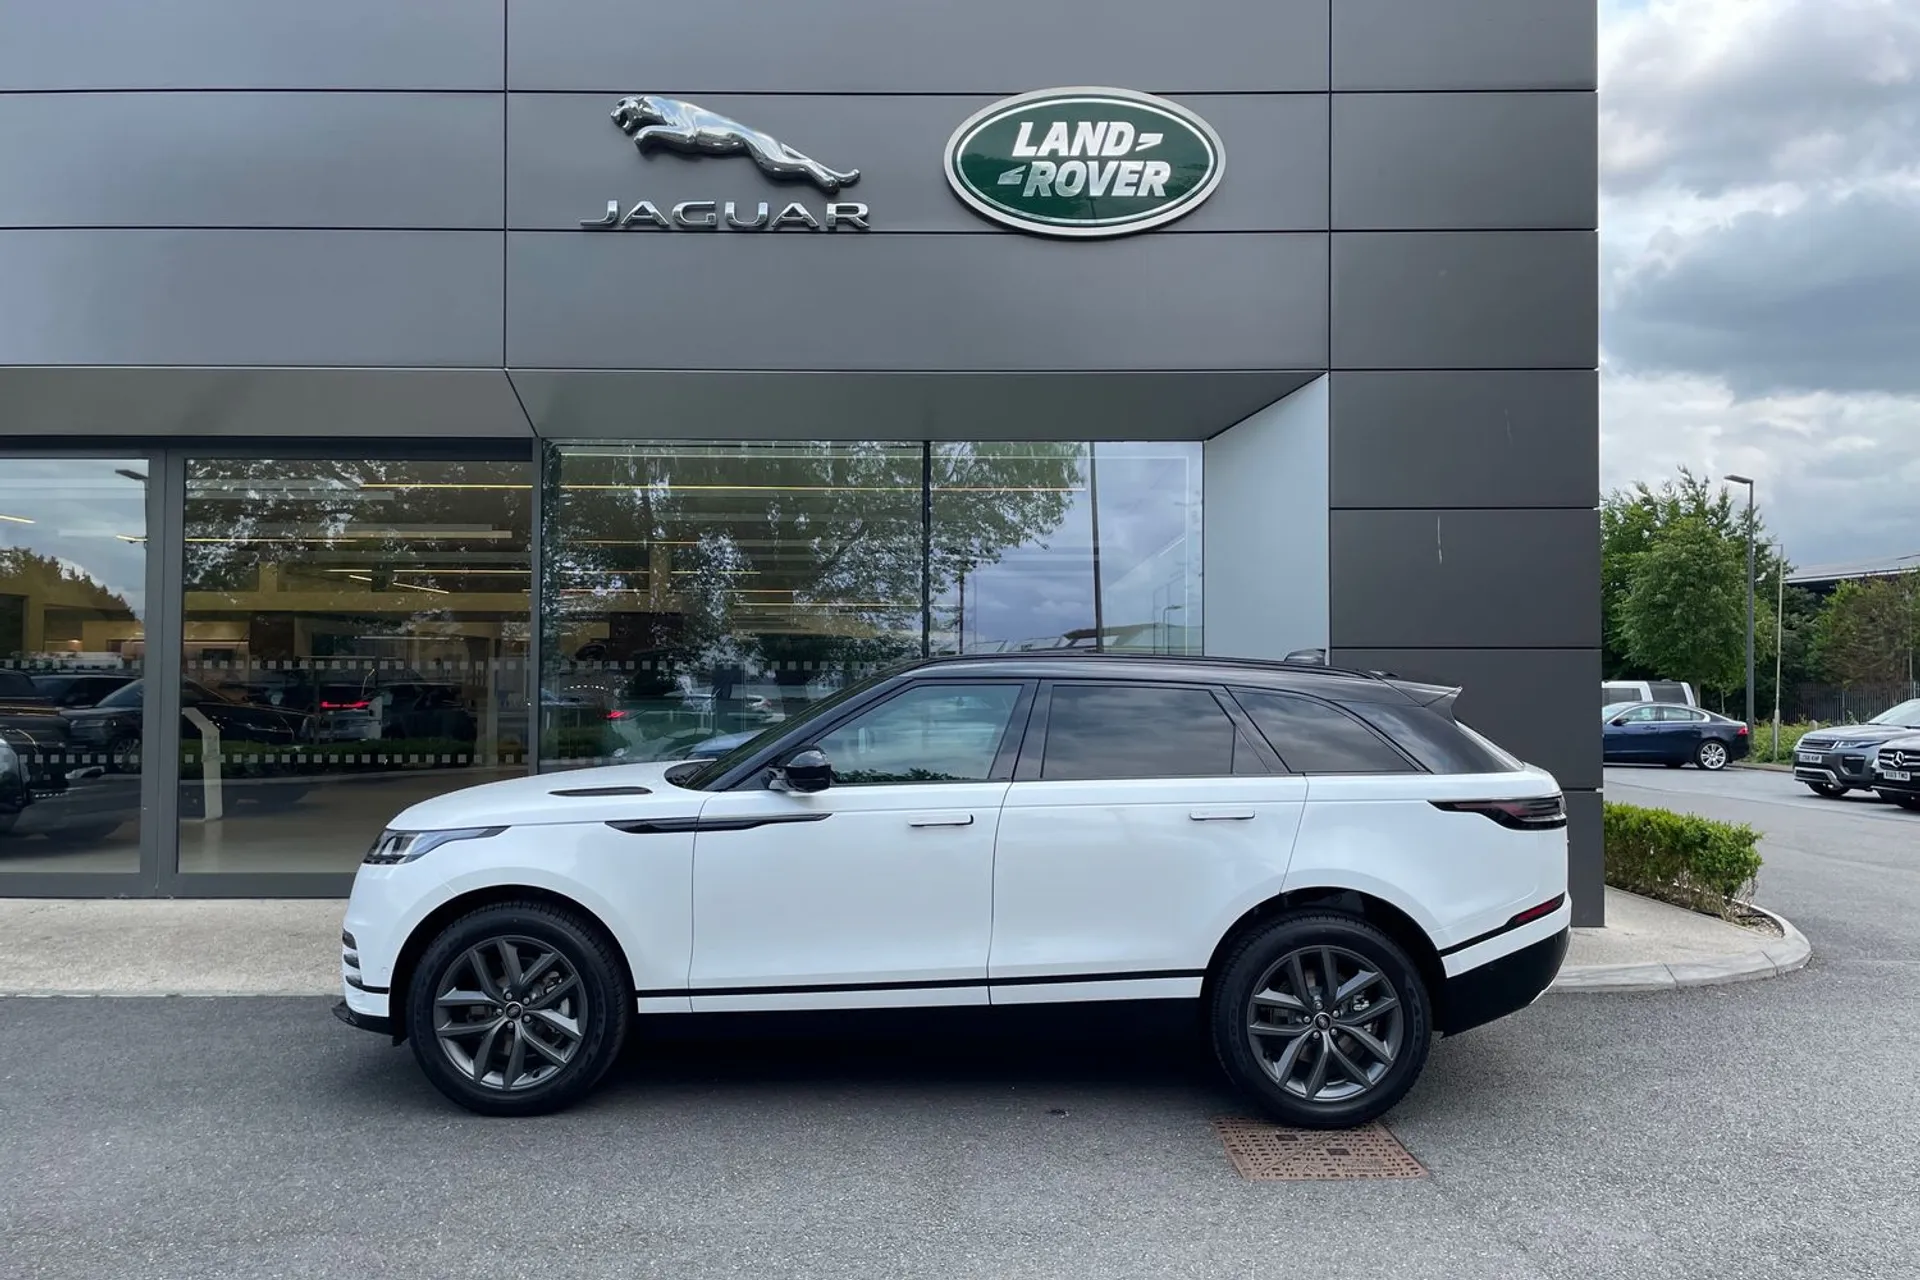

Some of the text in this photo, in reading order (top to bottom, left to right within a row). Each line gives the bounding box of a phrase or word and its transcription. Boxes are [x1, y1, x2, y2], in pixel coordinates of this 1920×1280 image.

[1012, 121, 1136, 157] LAND
[1022, 160, 1172, 197] ROVER
[579, 200, 870, 230] JAGUAR
